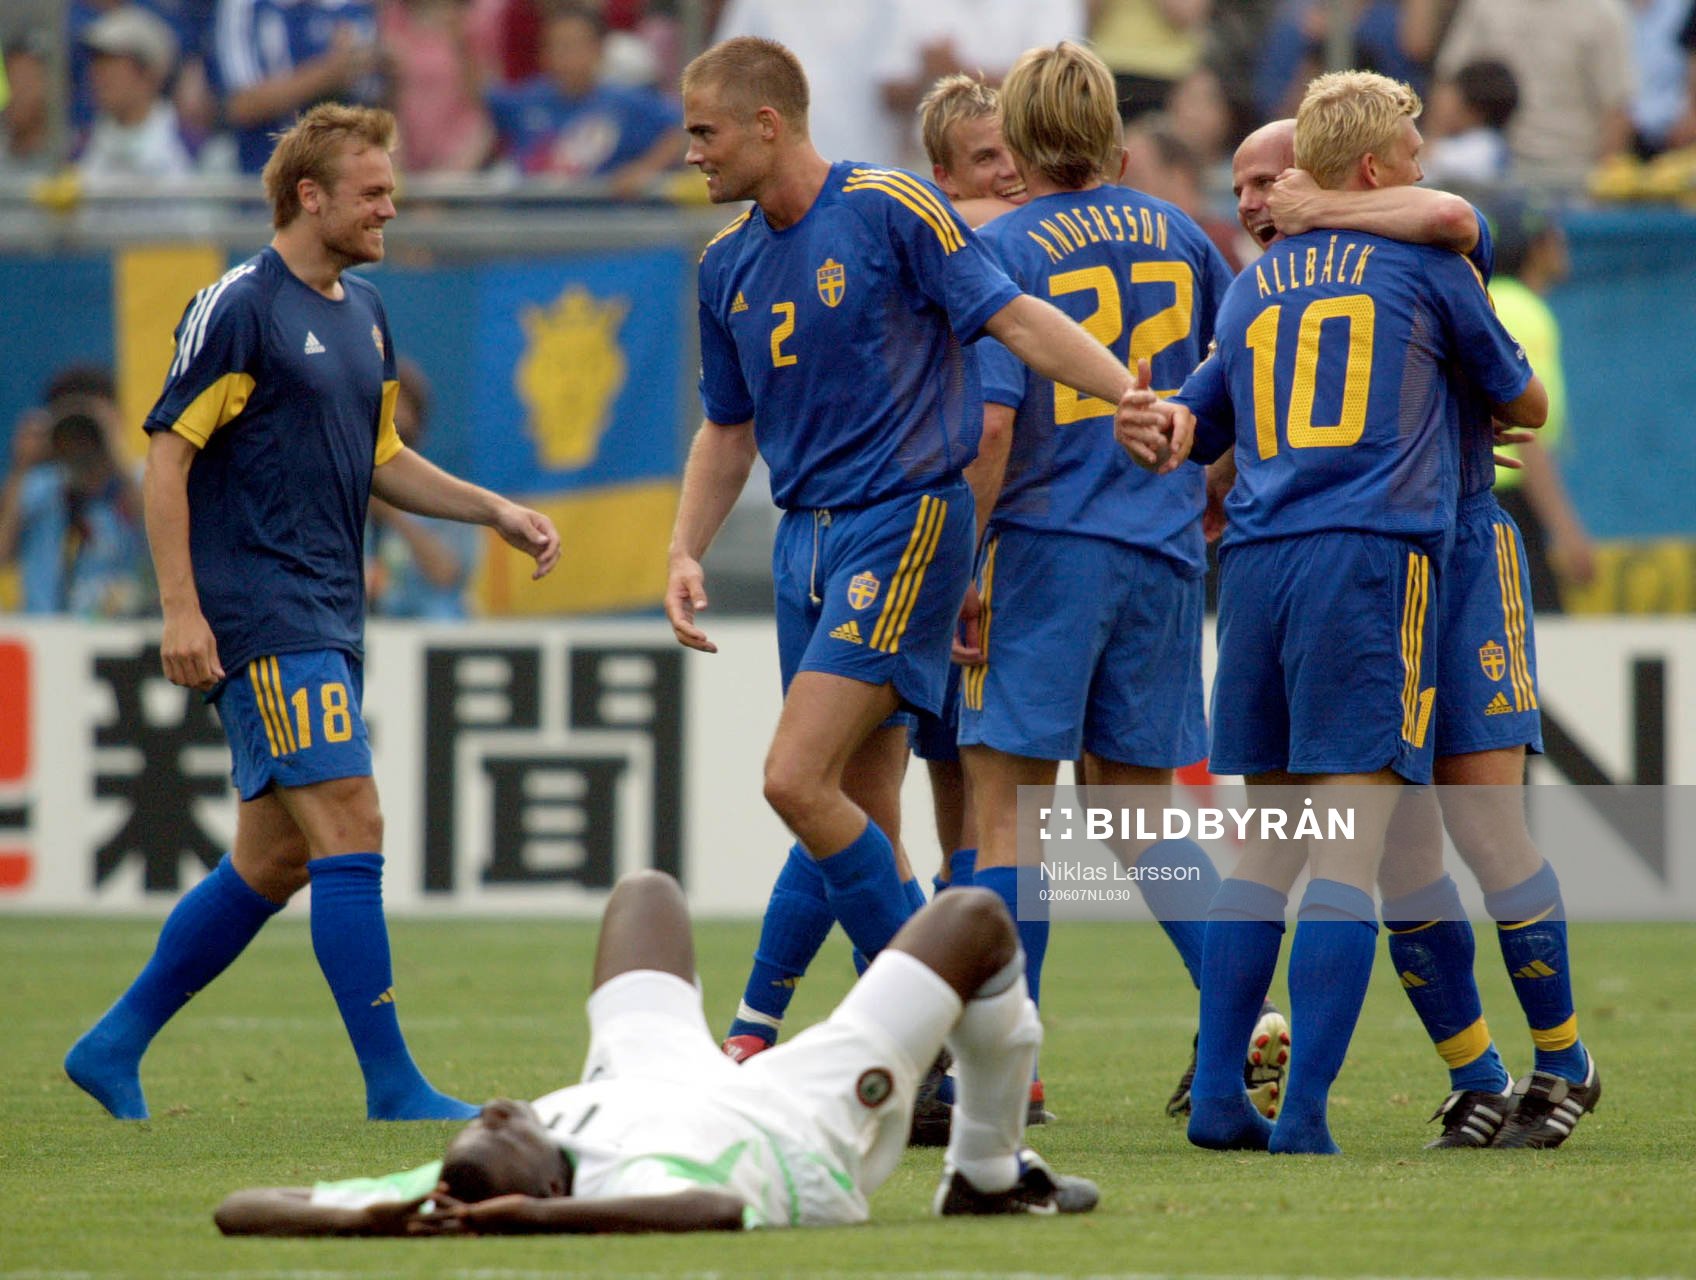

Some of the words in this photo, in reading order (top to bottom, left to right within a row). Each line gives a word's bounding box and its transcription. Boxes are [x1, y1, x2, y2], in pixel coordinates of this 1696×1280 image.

[1028, 205, 1168, 264] ANDERSSON
[1256, 235, 1376, 298] ALLBÄCK
[770, 301, 797, 368] 2
[1048, 261, 1194, 425] 22
[1246, 294, 1375, 460] 10
[292, 682, 352, 749] 18
